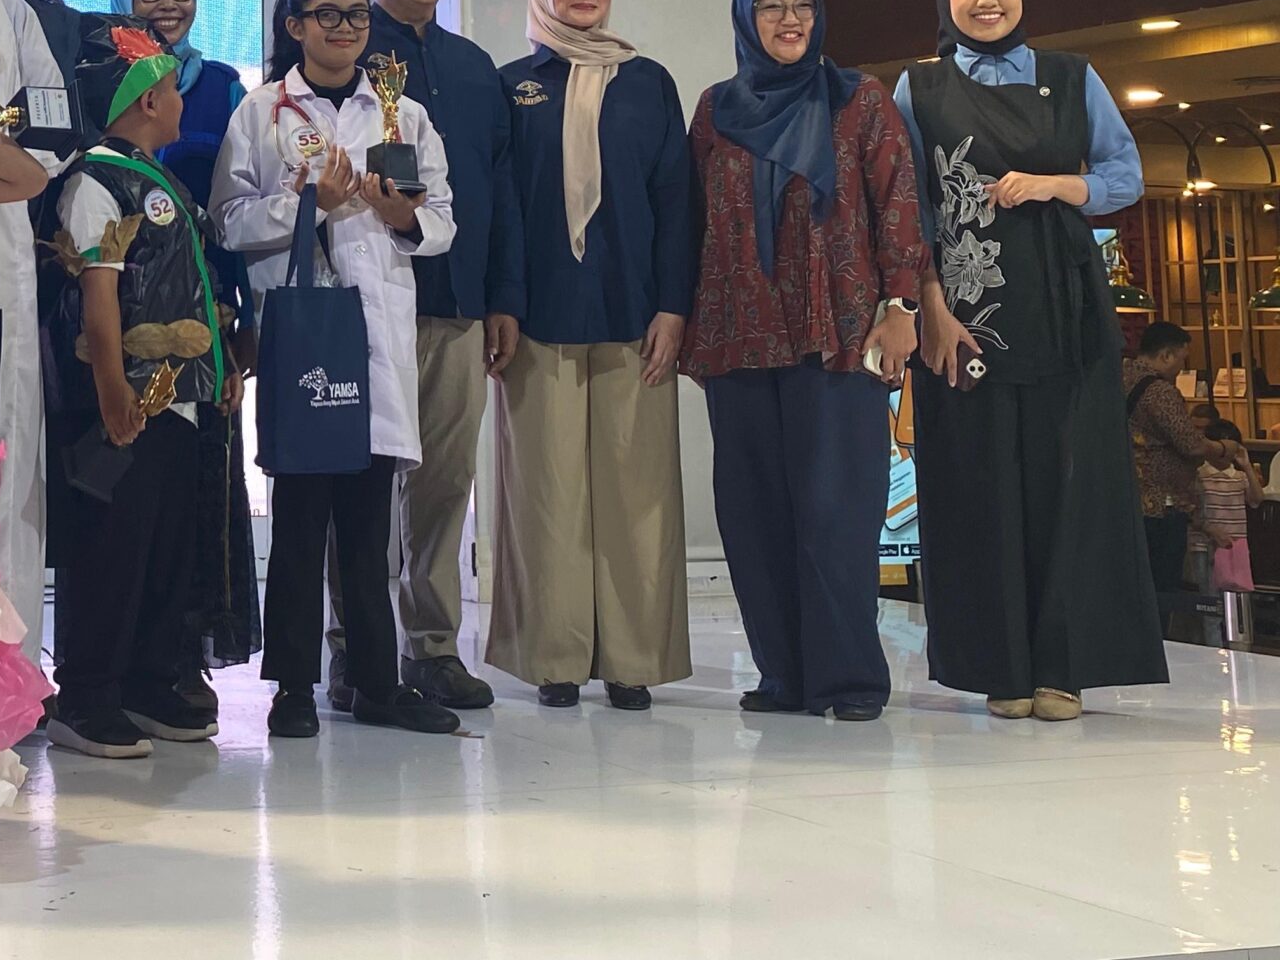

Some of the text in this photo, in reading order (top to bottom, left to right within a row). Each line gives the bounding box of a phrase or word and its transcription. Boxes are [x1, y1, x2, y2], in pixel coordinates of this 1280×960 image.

[298, 133, 320, 146] 55
[150, 199, 172, 218] 52
[328, 381, 360, 398] YAMSA
